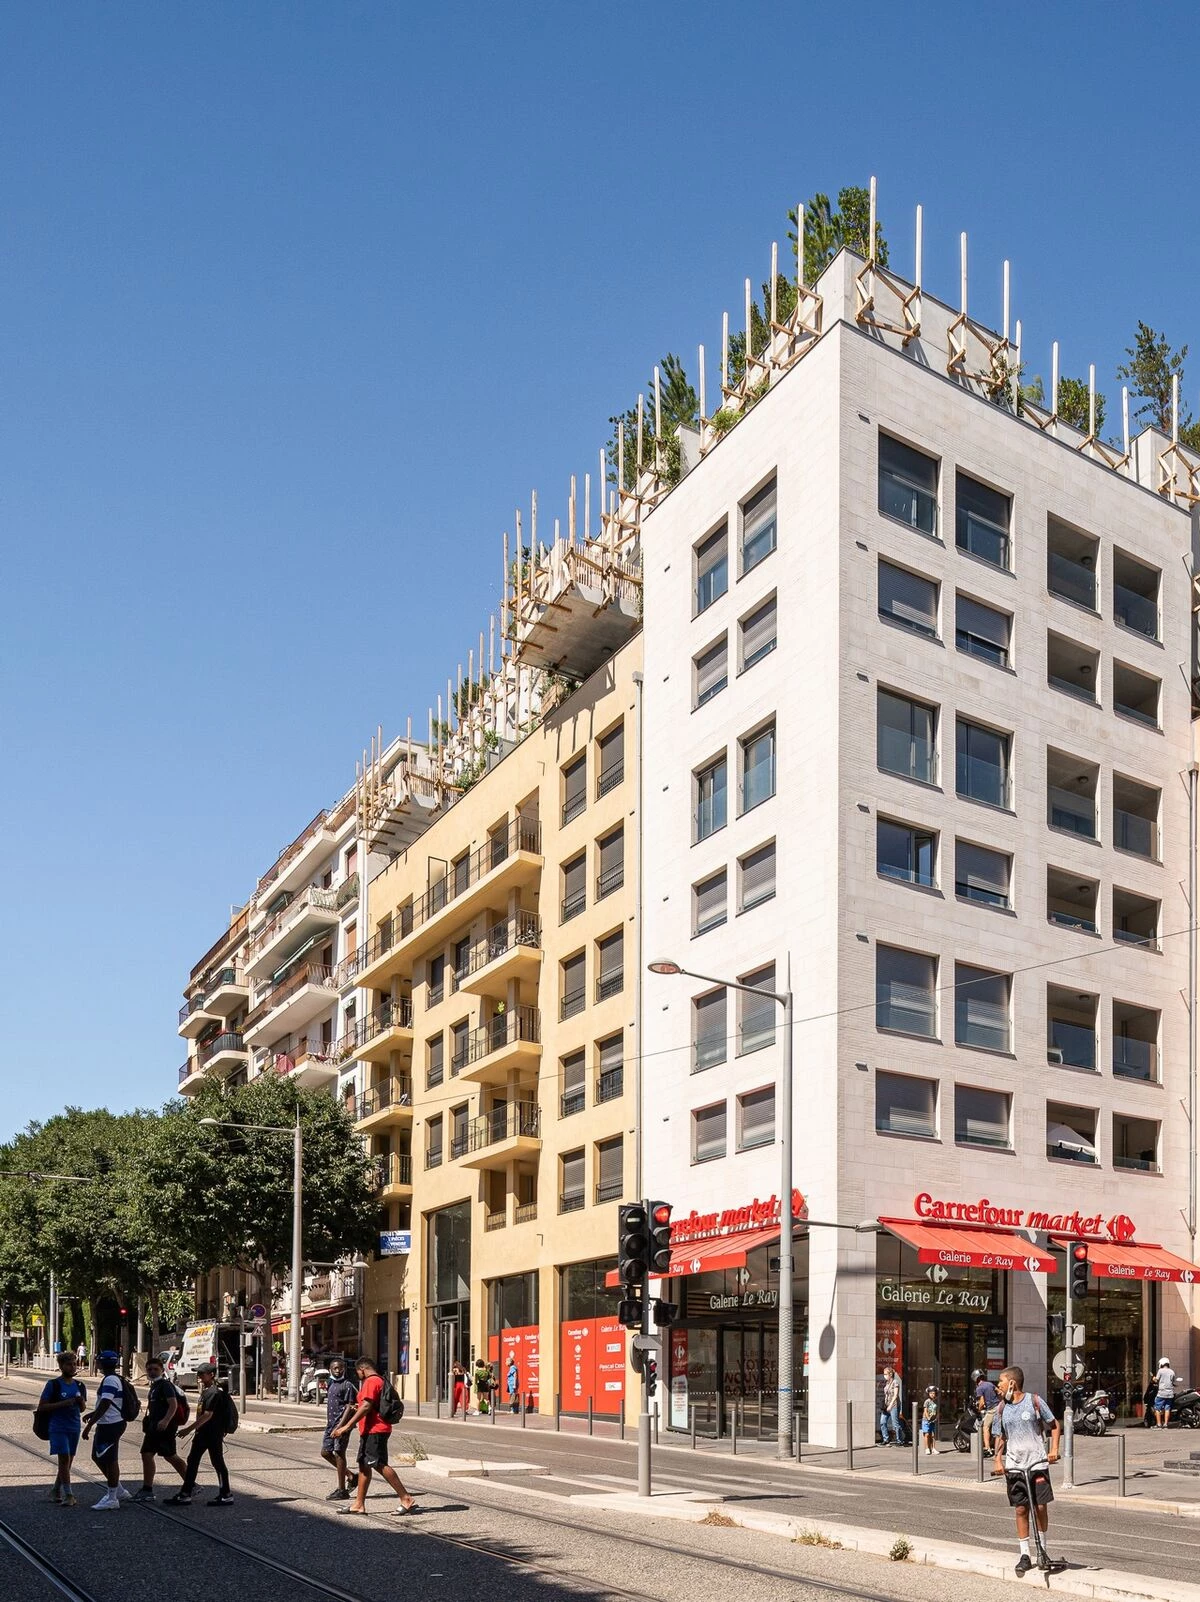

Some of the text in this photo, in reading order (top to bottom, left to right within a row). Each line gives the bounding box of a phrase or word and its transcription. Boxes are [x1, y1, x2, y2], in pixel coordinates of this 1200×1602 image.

[670, 1194, 779, 1237] rrefour market
[914, 1193, 1104, 1236] Carrefour market
[938, 1250, 1013, 1268] Galerie Le Ray
[1108, 1264, 1170, 1280] Galerie Le Ray
[709, 1290, 778, 1309] Galerie Le Ray
[881, 1286, 989, 1312] Galerie Le Ray
